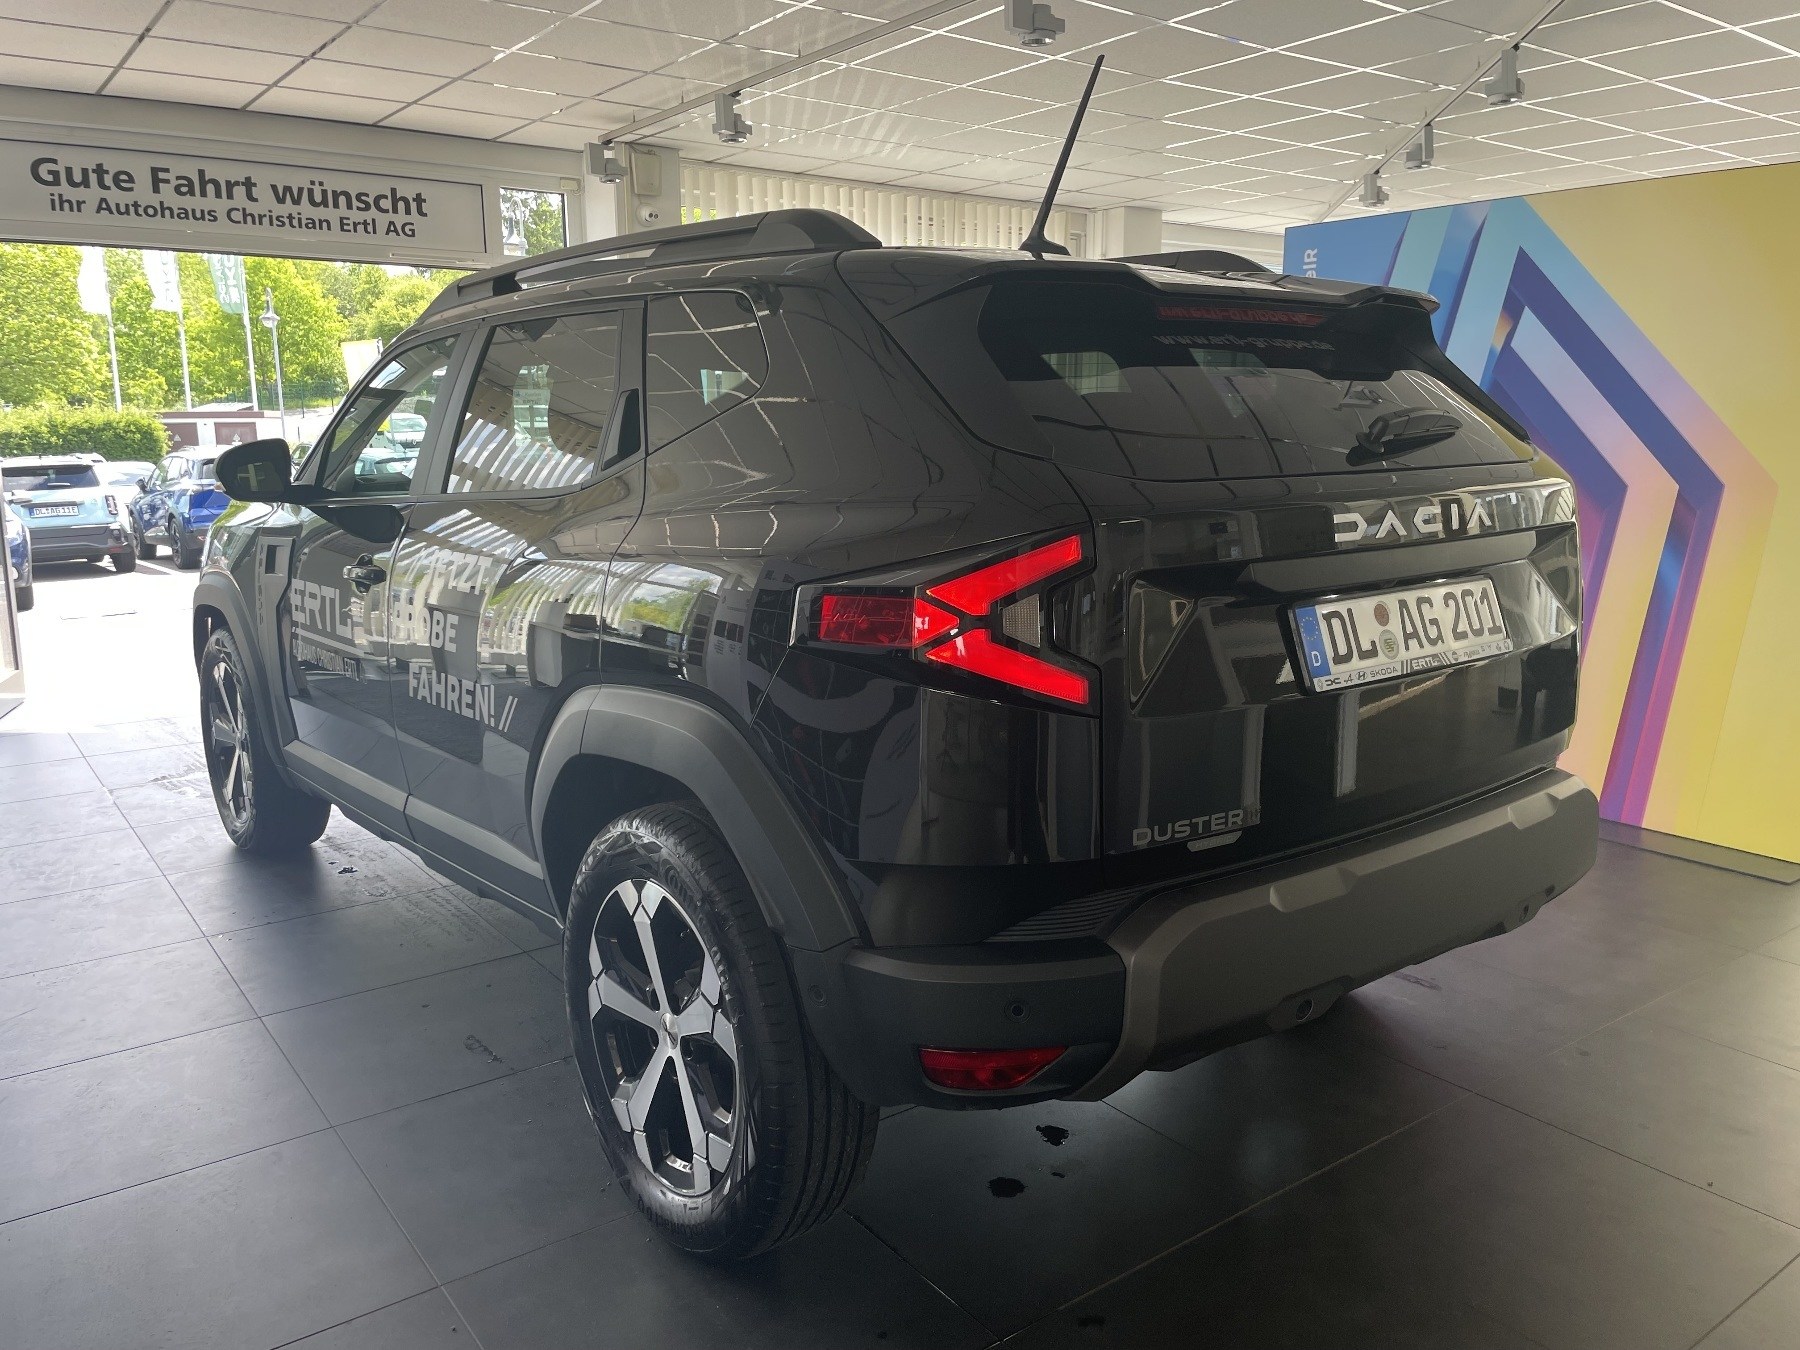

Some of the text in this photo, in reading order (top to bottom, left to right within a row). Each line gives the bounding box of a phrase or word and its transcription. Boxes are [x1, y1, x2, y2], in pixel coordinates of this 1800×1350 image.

[29, 157, 429, 218] Gute Fahrt wünscht
[49, 192, 416, 238] ihr Autohaus Christian Ertl AG
[1333, 498, 1493, 543] DACIA
[290, 578, 353, 640] ERTL
[392, 602, 460, 653] PROBE
[1321, 586, 1502, 666] DL AG 201
[1311, 650, 1322, 667] D
[408, 662, 496, 728] FAHREN!
[1132, 808, 1244, 847] DUSTER
